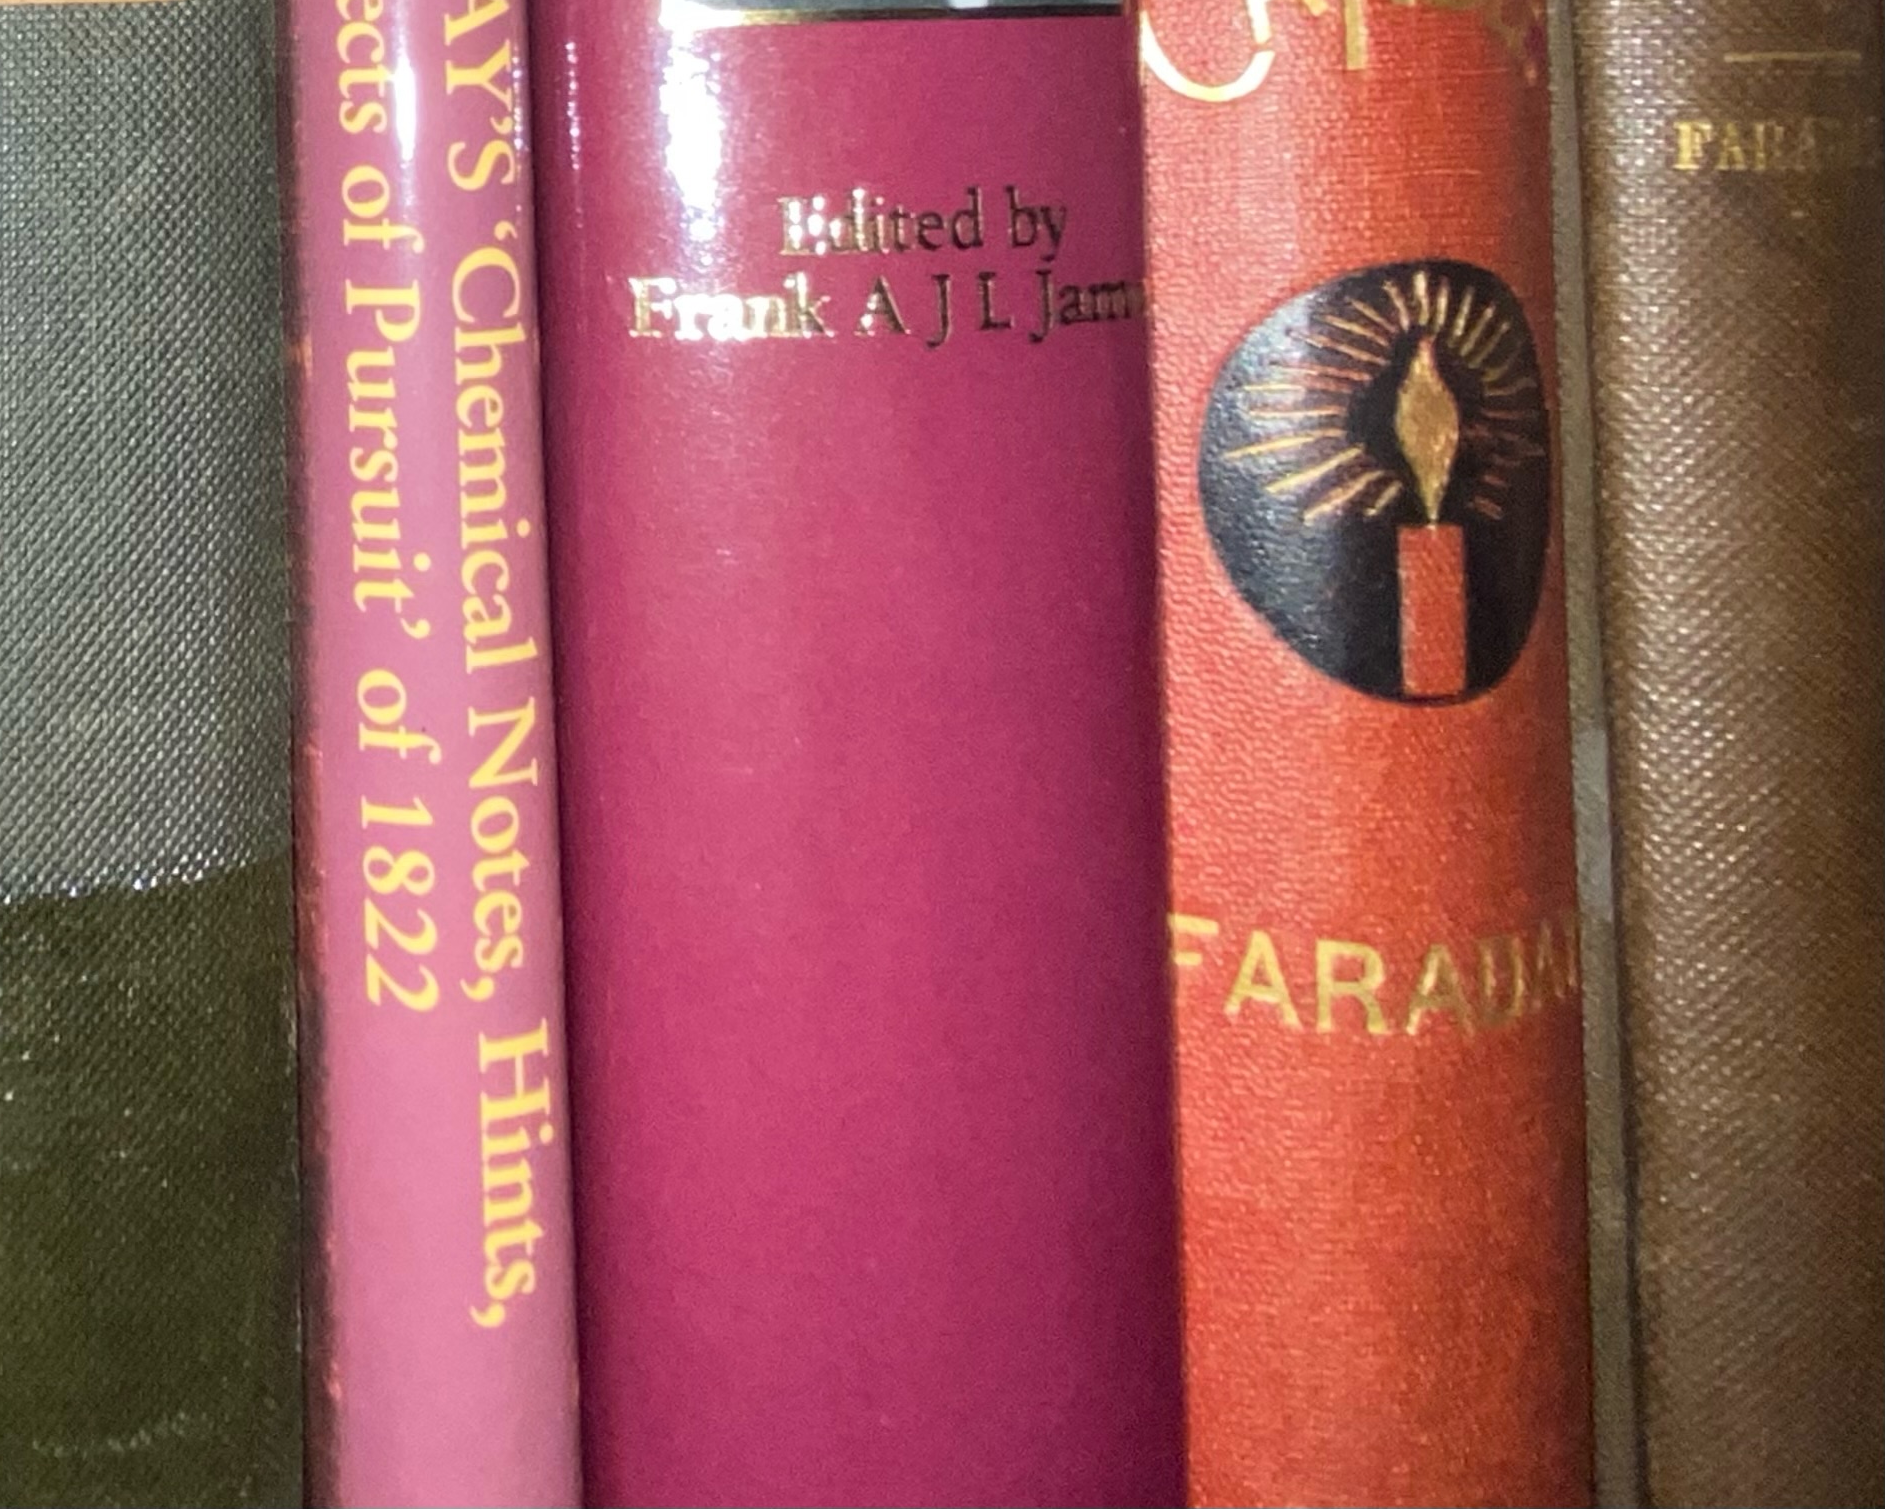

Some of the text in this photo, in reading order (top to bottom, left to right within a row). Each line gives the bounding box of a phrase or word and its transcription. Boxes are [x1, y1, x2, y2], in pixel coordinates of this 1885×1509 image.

[341, 165, 426, 251] of
[778, 185, 1069, 262] Edited by
[628, 270, 838, 343] Frank
[855, 275, 913, 337] A
[926, 273, 952, 350] J
[977, 270, 1014, 331] L
[356, 669, 442, 765] of
[459, 697, 539, 1003] Notes,
[361, 795, 440, 1014] 1822
[469, 1018, 555, 1329] Hints,
